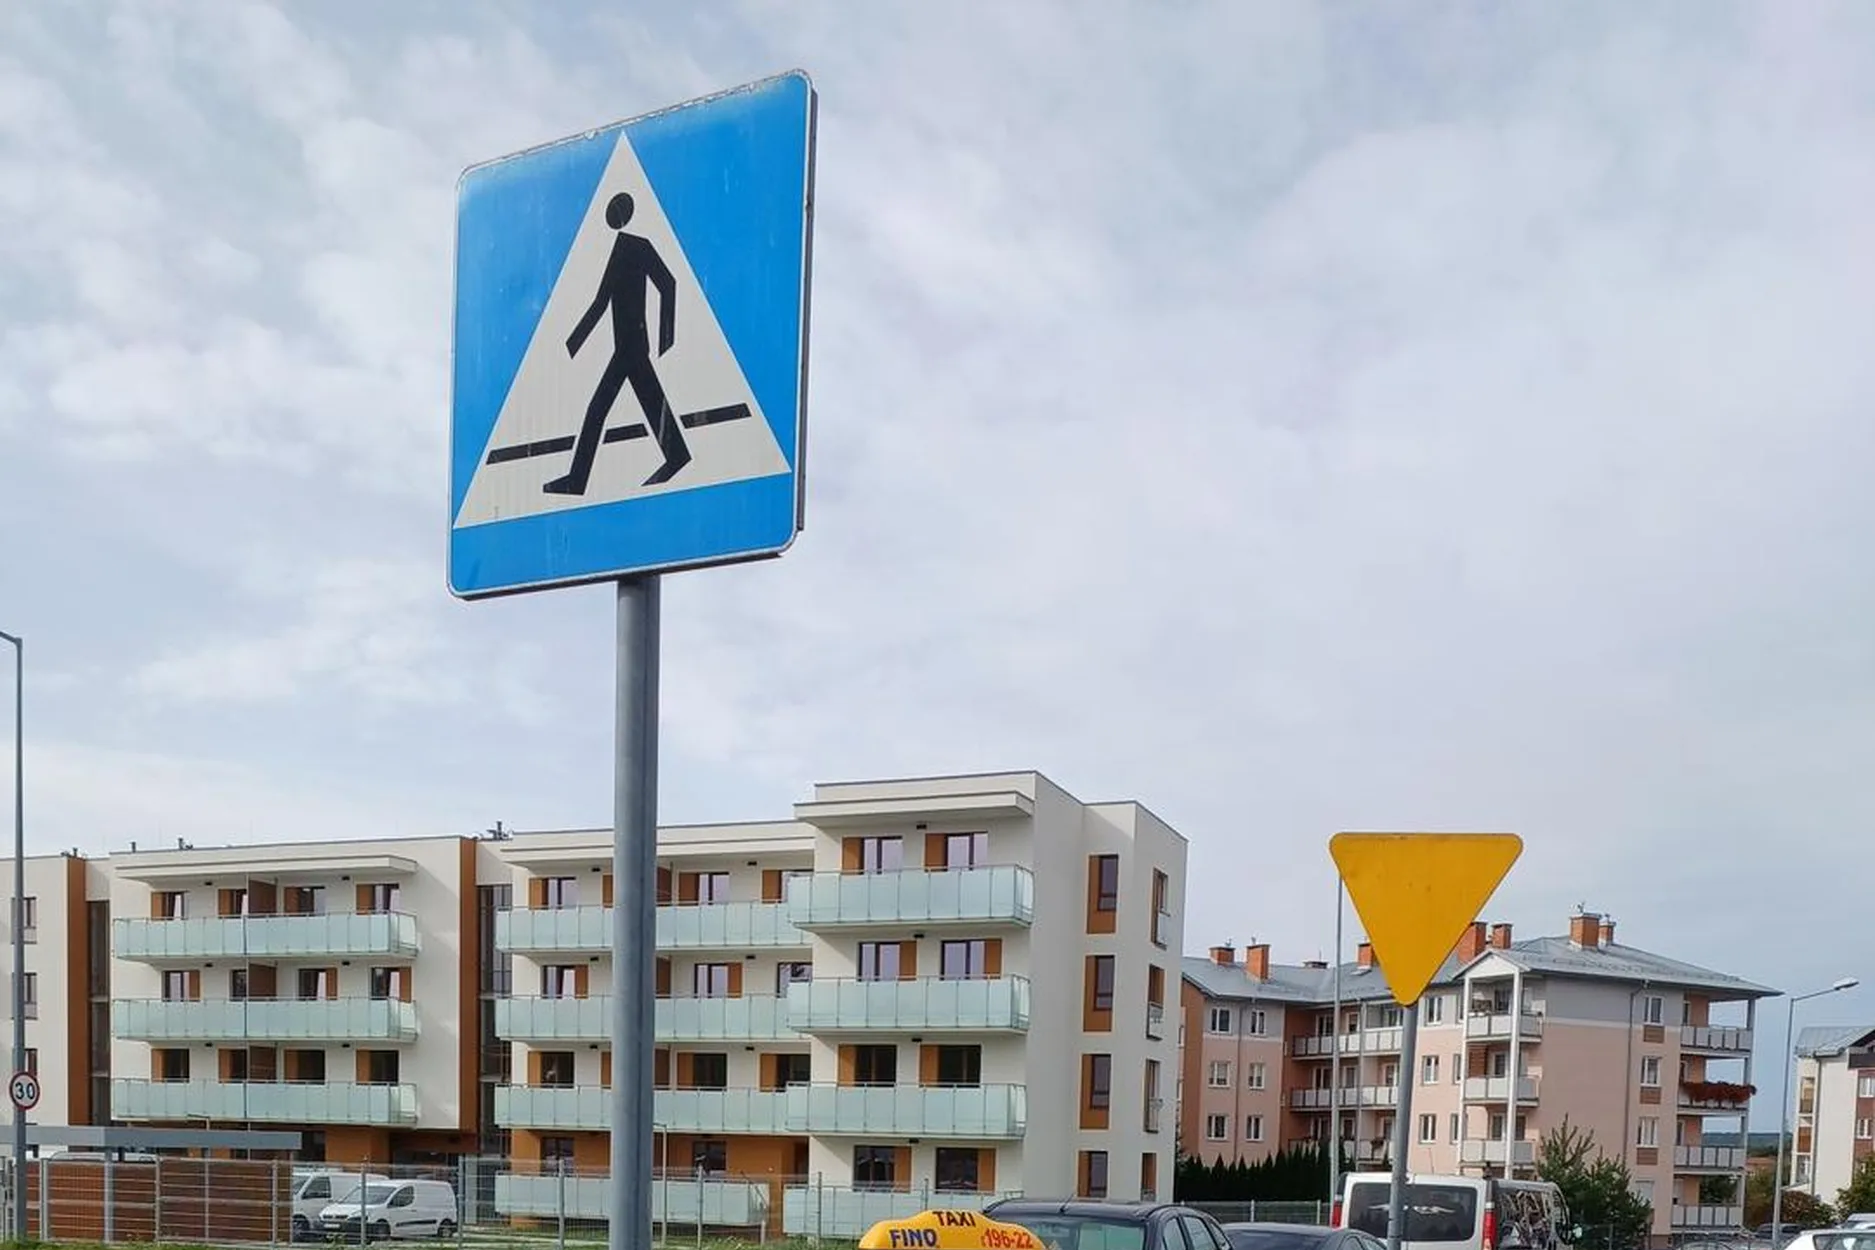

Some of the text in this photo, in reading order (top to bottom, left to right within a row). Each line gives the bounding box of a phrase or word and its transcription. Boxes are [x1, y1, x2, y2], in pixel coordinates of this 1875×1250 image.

[15, 1082, 35, 1100] 30
[932, 1210, 976, 1228] TAXI
[889, 1228, 937, 1248] FINO
[985, 1227, 1034, 1249] 196-22
